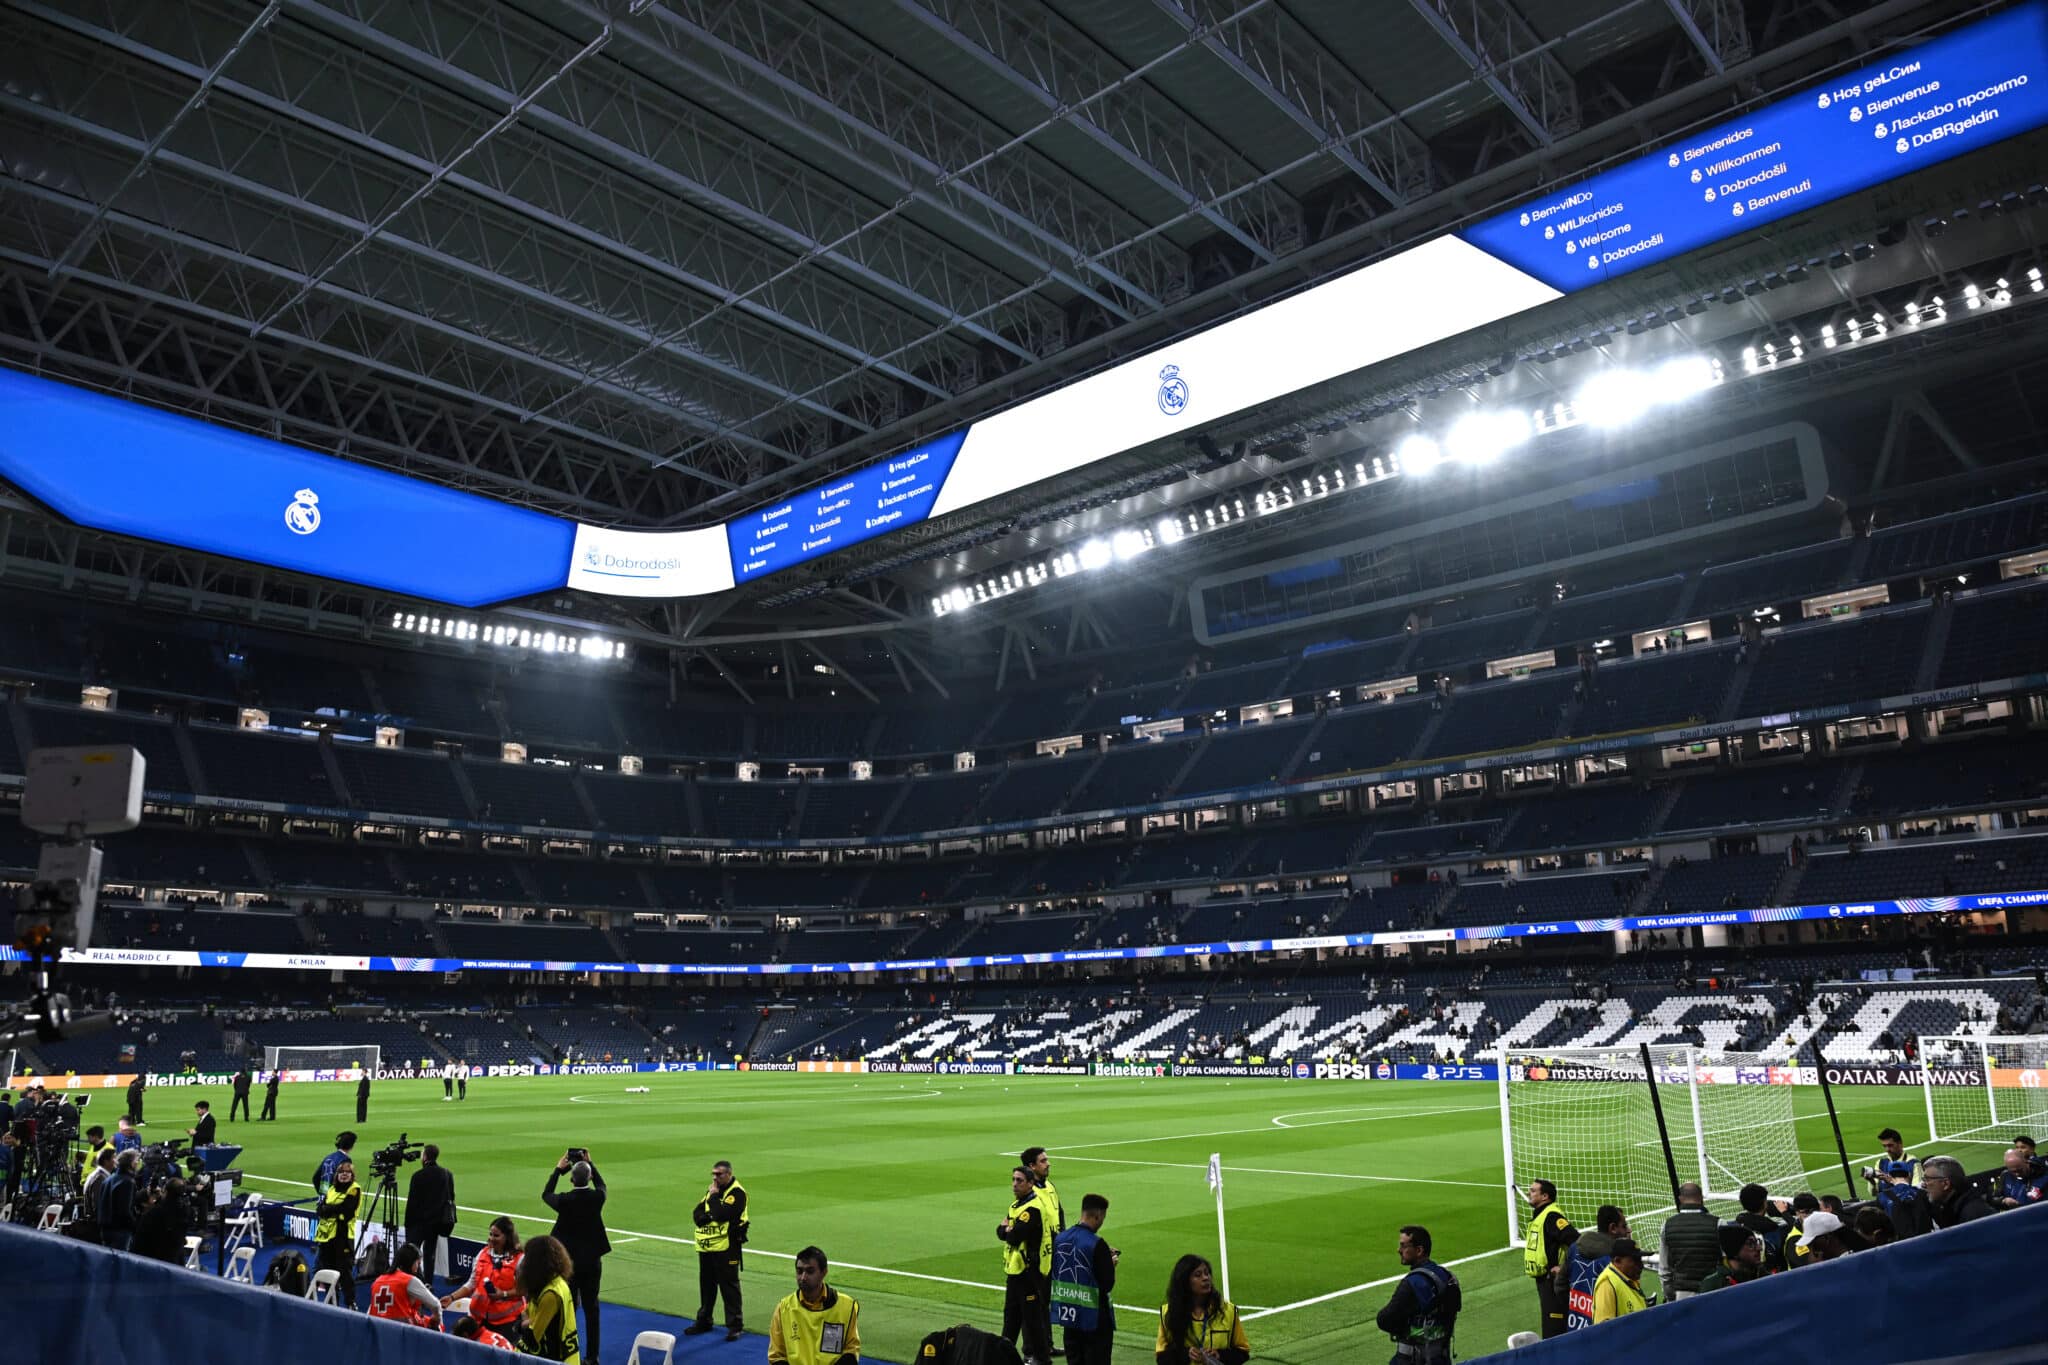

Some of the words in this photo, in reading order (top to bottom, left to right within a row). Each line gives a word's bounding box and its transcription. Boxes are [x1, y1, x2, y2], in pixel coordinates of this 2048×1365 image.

[1867, 81, 1940, 116] Bienvenue
[1683, 128, 1753, 162] Bienvenidos
[1705, 142, 1781, 177] Willkommen
[1719, 162, 1788, 197] Dobrodošli
[1747, 179, 1812, 211] Benvenuti
[1531, 192, 1593, 222] Bem-viNDo
[1578, 223, 1631, 249] Welcome
[1602, 233, 1664, 264] Dobrodošli
[604, 554, 681, 570] Dobrodošli
[1978, 897, 2004, 907] UEFA
[1637, 918, 1657, 927] UEFA
[1658, 915, 1705, 926] CHAMPIONS
[1706, 914, 1738, 923] LEAGUE
[93, 952, 115, 961] REAL
[117, 953, 154, 962] MADRID
[288, 958, 298, 966] AC
[300, 958, 326, 967] MILAN
[487, 1065, 535, 1076] PEPSI
[572, 1064, 632, 1074] crypto.com
[669, 1063, 697, 1072] PS5
[751, 1063, 796, 1071] mastercard
[871, 1062, 897, 1073] QATAR
[900, 1062, 933, 1072] AIRWAYS
[950, 1063, 1002, 1074] crypto.com
[1094, 1063, 1153, 1076] Heineken
[1183, 1066, 1202, 1076] UEFA
[1203, 1066, 1248, 1076] CHAMPIONS
[1250, 1066, 1280, 1076] LEAGUE
[1315, 1064, 1371, 1080] PEPSI
[1442, 1067, 1483, 1079] PS5
[145, 1073, 232, 1087] Heineken
[259, 1071, 299, 1083] FeEx
[315, 1068, 352, 1081] FedEx
[378, 1069, 414, 1080] QATAR
[1552, 1067, 1648, 1081] mastercard
[1736, 1067, 1793, 1084] FedEx
[1825, 1069, 1889, 1085] QATAR
[1896, 1069, 1981, 1086] AIRWAYS
[457, 1252, 475, 1268] UEF
